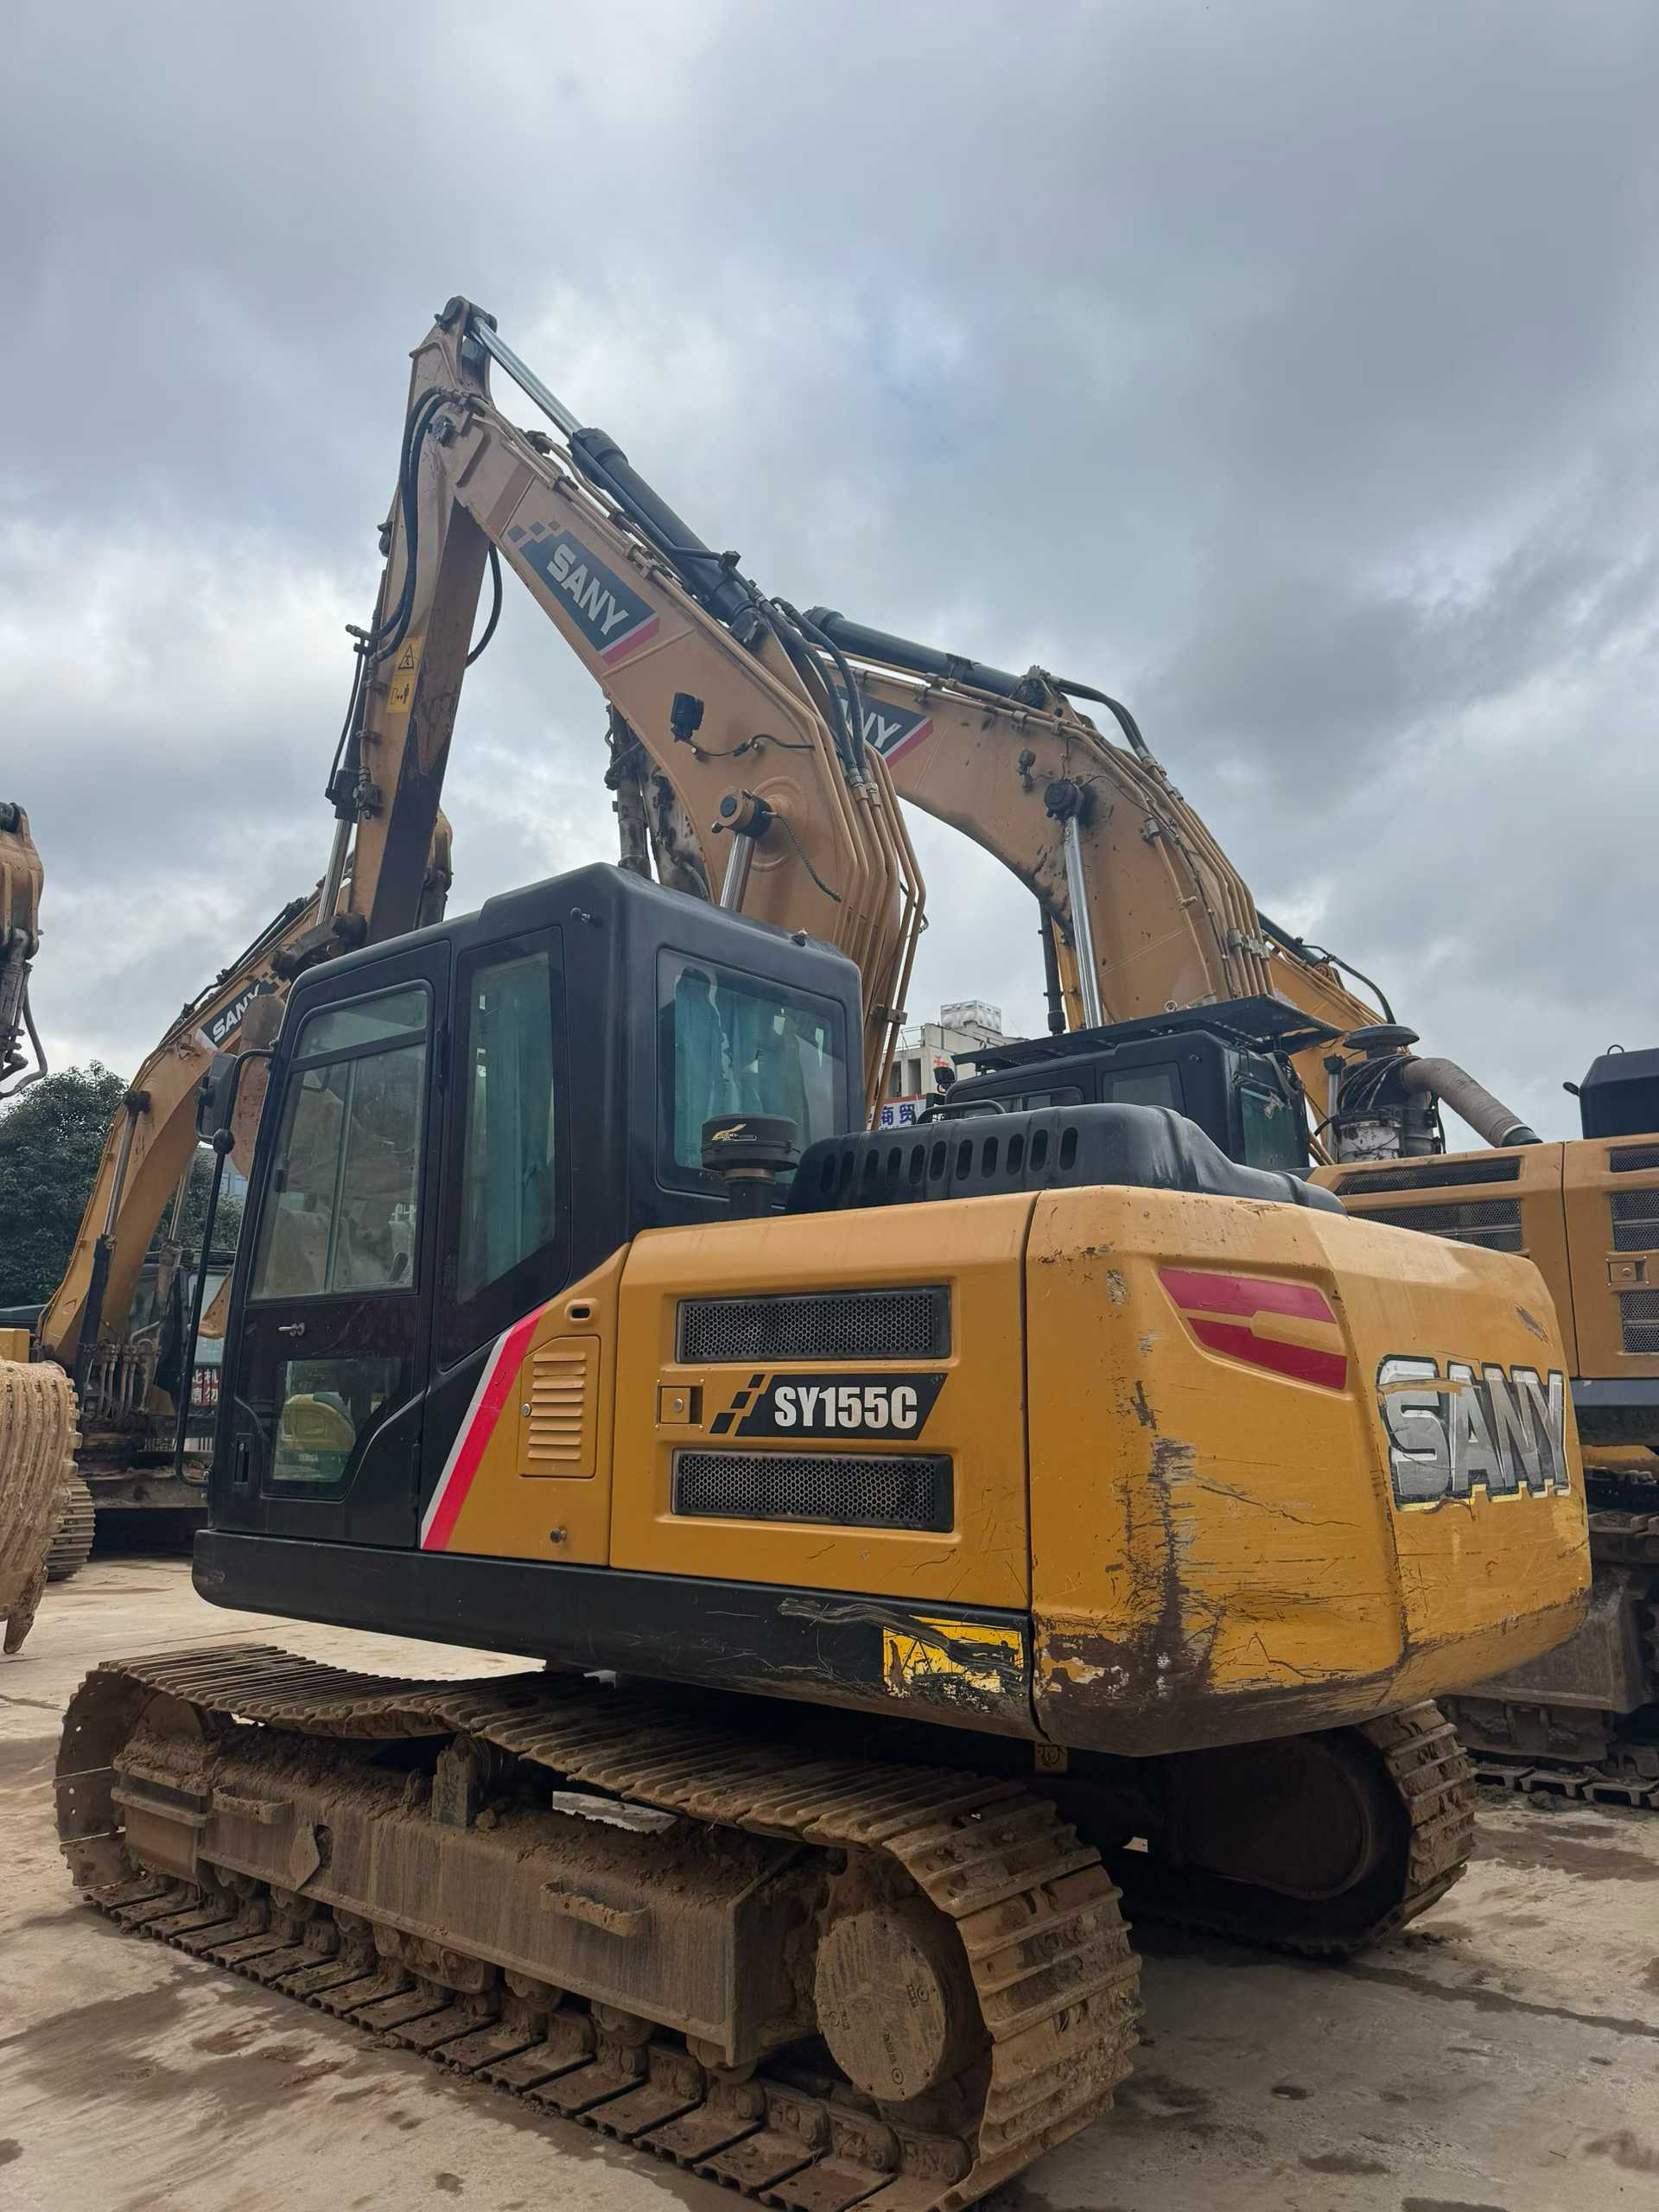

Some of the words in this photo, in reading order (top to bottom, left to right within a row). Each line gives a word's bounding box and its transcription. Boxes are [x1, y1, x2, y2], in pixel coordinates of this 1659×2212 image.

[547, 543, 629, 635] SANY
[868, 1103, 917, 1125] 商贸
[774, 1386, 918, 1429] SY155C
[1377, 1355, 1569, 1503] SANY
